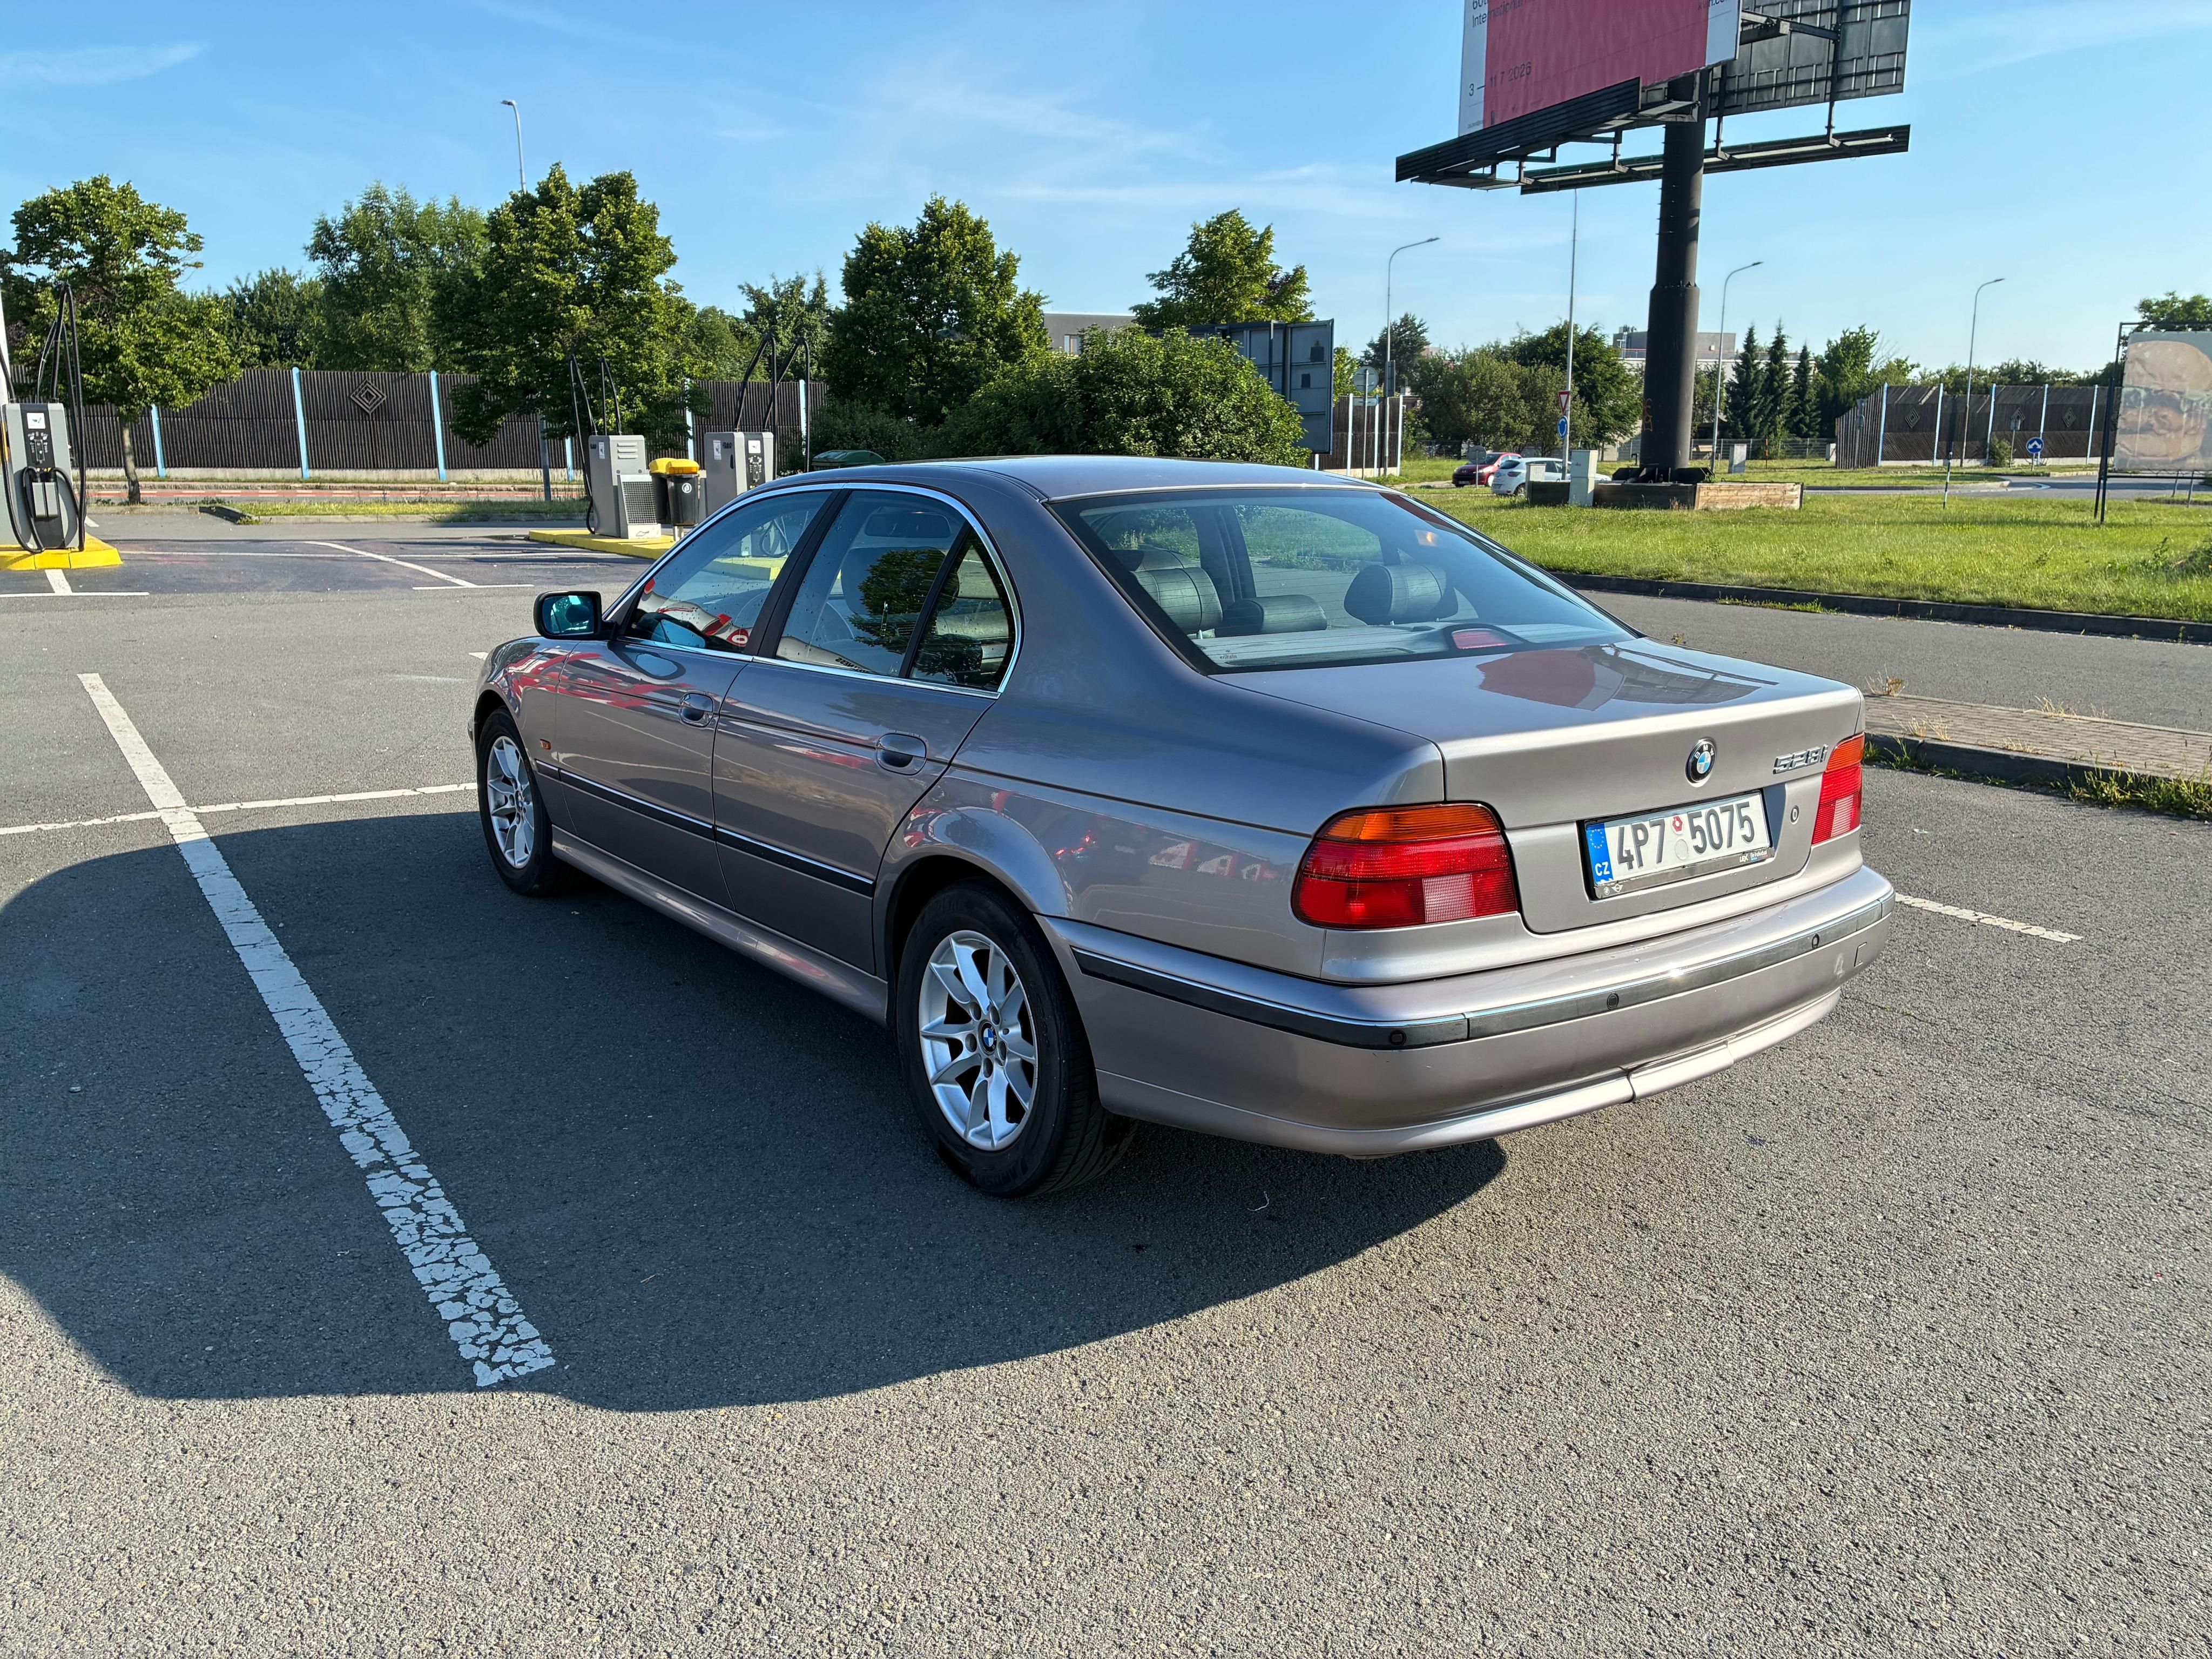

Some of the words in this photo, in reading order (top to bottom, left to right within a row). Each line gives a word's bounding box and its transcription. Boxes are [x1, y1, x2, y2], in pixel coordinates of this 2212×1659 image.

[1468, 83, 1475, 97] 3
[1490, 74, 1497, 87] 11
[1500, 71, 1505, 84] 7
[1508, 62, 1532, 82] 2026
[1773, 744, 1829, 774] 528i
[1617, 817, 1665, 871] 4P7
[1687, 801, 1755, 854] 5075
[1595, 861, 1610, 876] CZ
